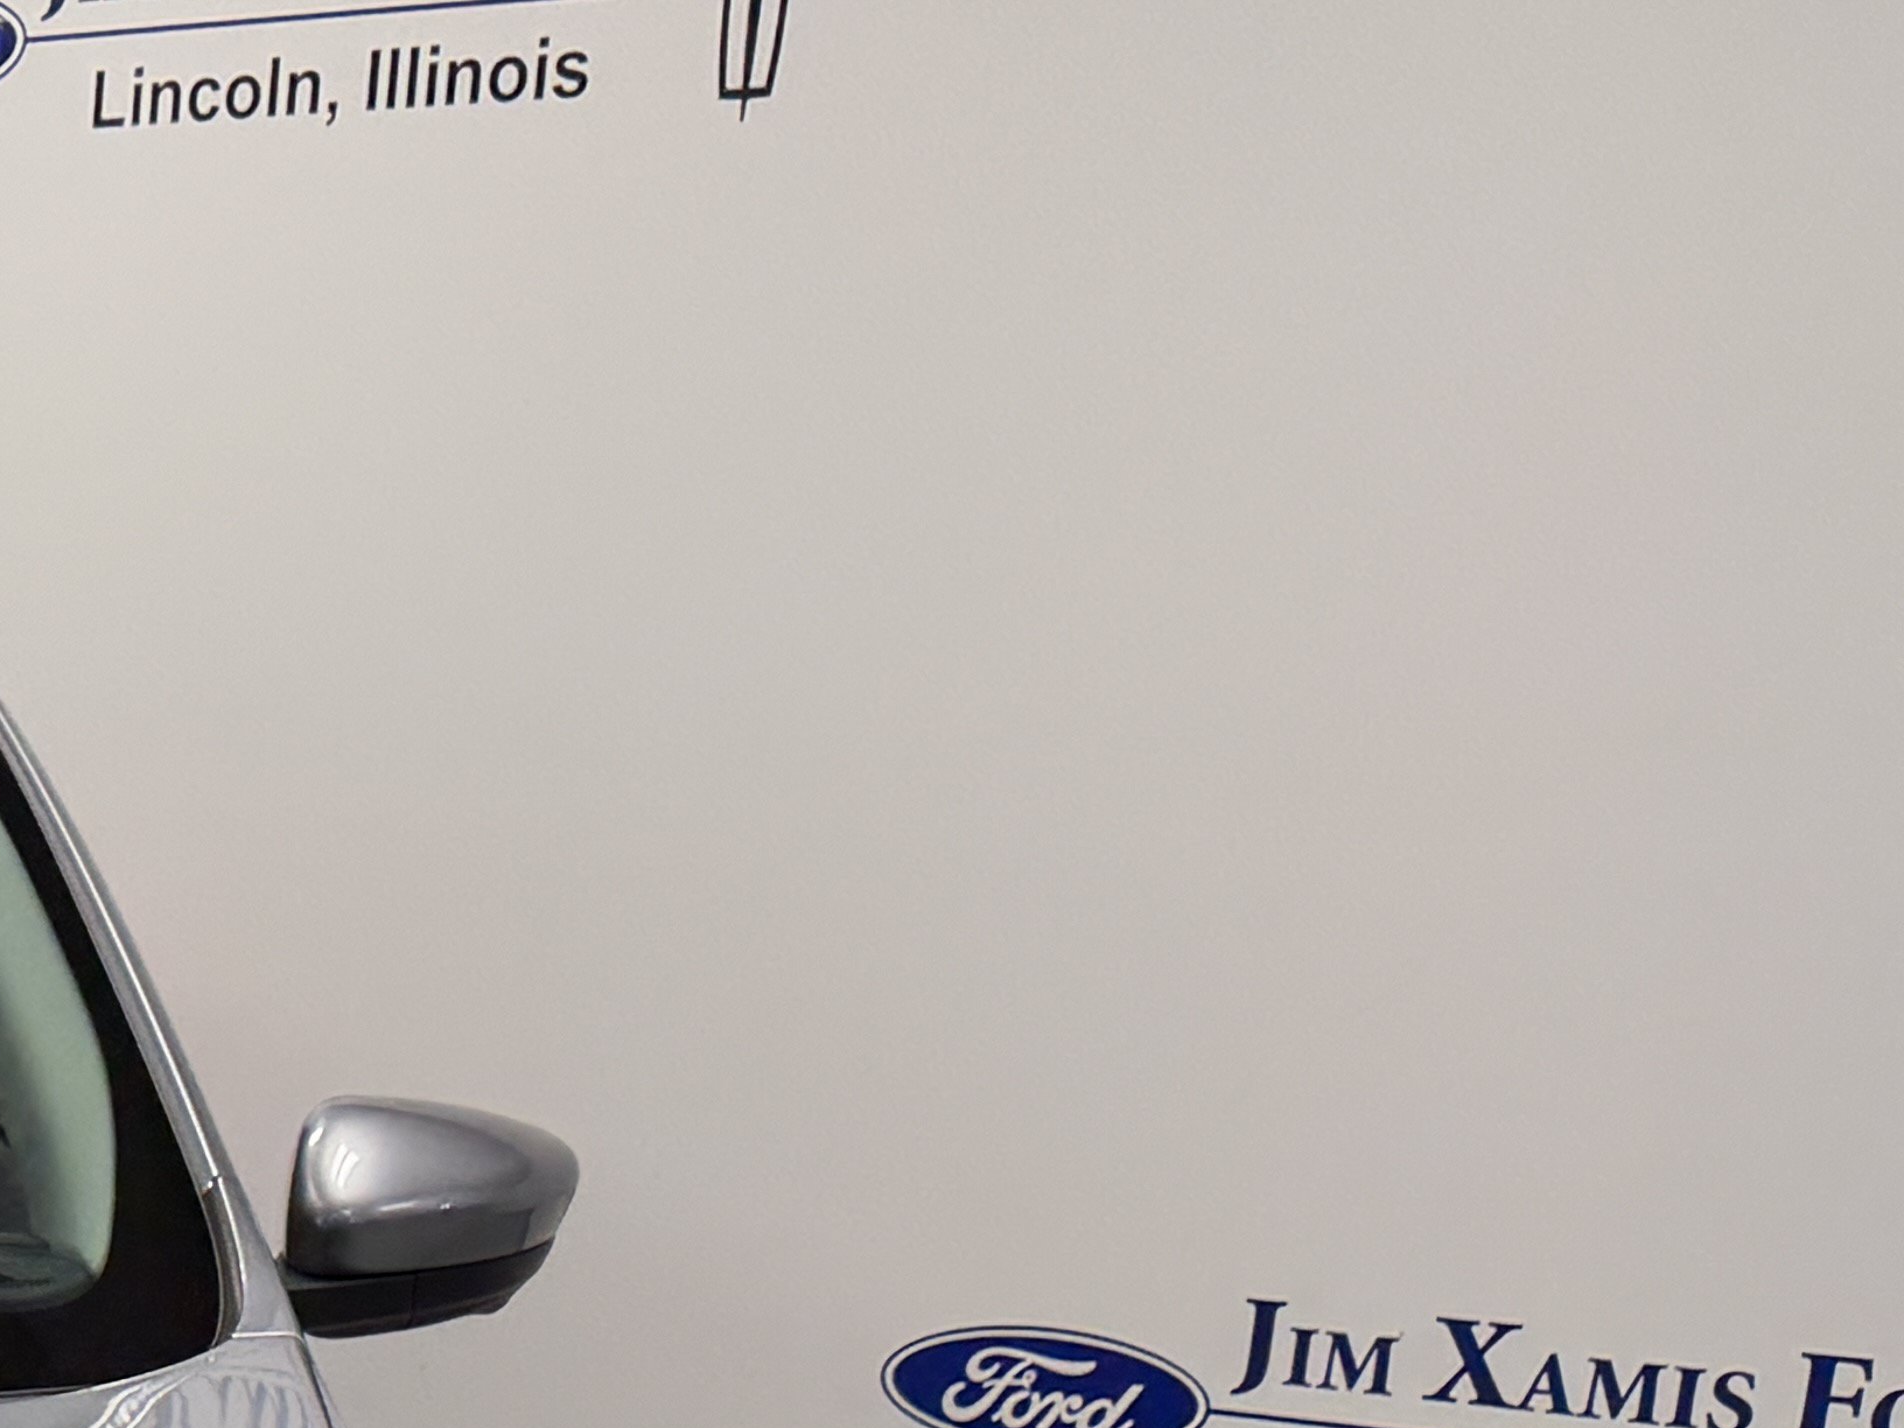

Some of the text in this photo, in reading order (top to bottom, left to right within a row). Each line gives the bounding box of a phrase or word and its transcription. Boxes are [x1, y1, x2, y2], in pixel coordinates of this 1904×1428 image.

[92, 36, 588, 129] Lincoln, Illinois
[1229, 1298, 1400, 1397] JIM
